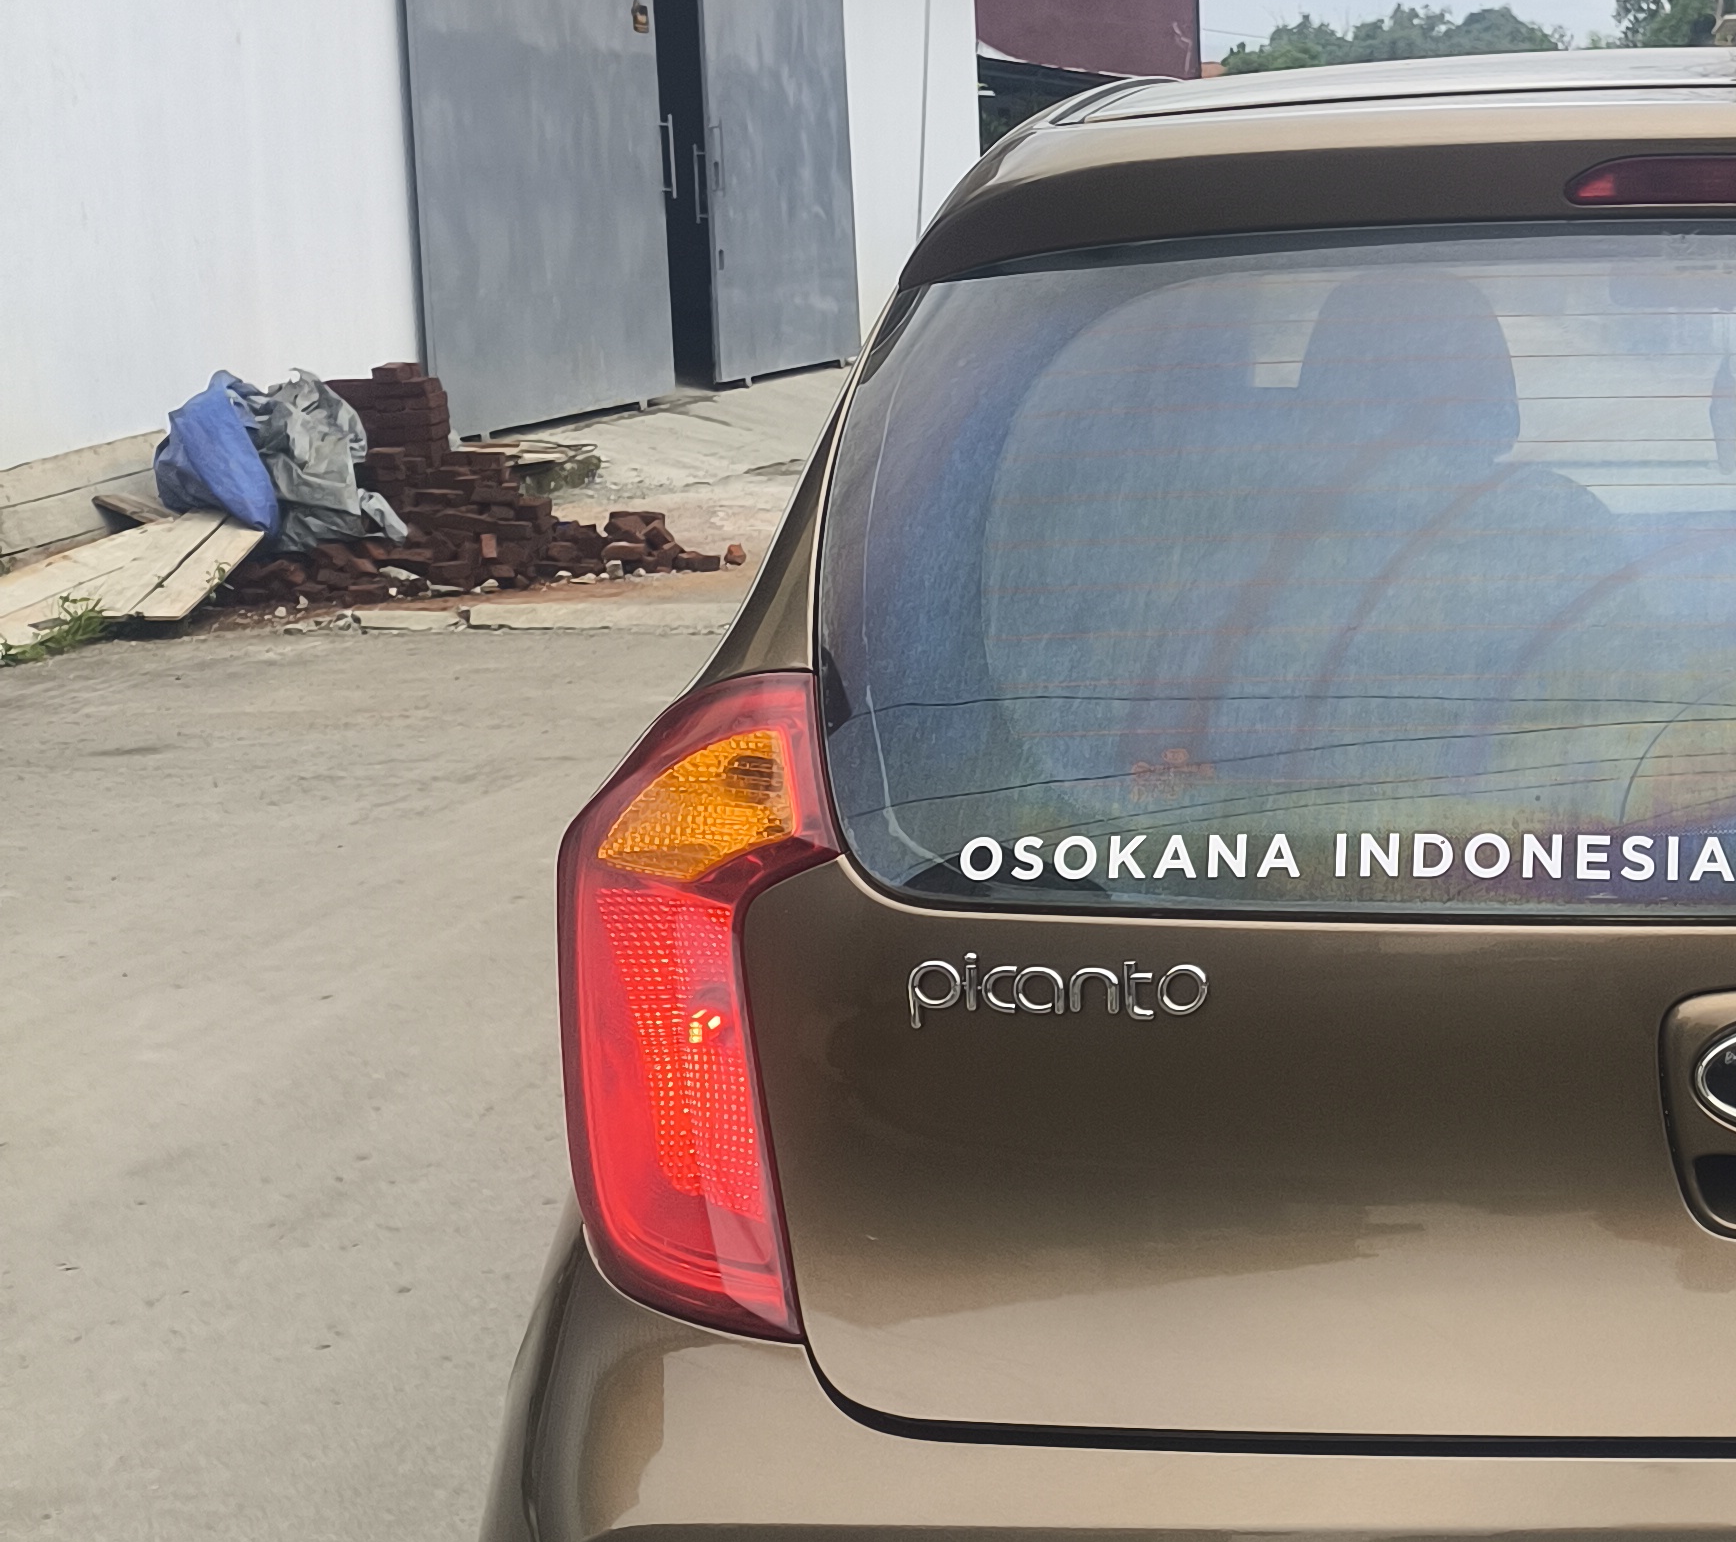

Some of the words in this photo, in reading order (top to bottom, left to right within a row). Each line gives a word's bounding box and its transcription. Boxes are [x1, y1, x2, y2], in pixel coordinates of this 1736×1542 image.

[961, 834, 1300, 880] OSOKANA
[1336, 833, 1734, 881] INDONESIA
[907, 952, 1208, 1028] picanto
